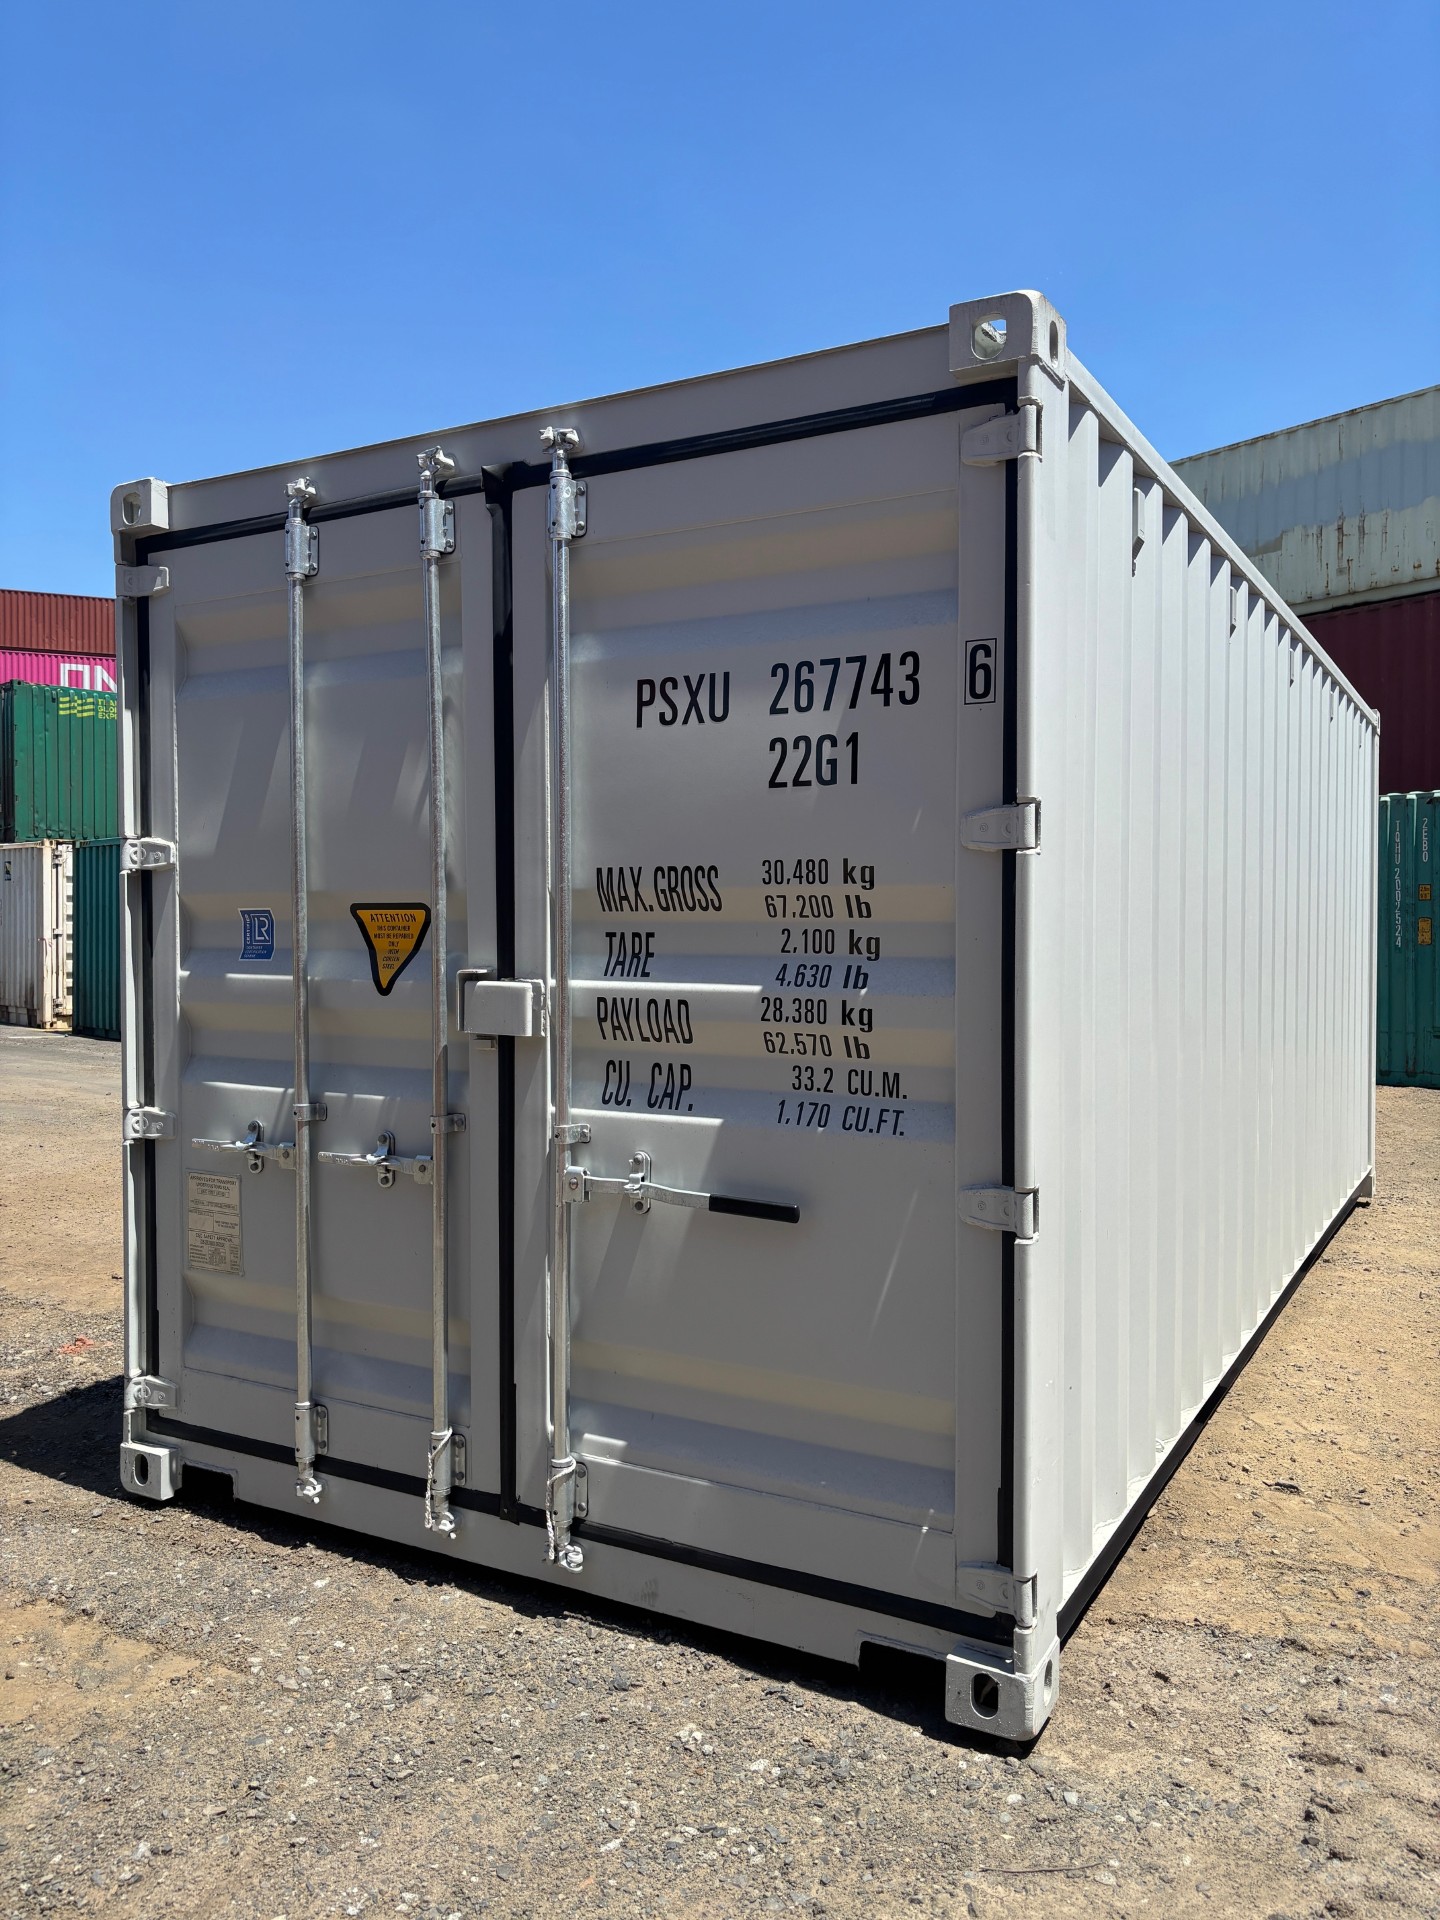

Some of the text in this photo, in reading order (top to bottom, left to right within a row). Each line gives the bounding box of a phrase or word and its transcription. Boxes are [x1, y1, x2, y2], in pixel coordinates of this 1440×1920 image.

[637, 644, 991, 728] PSXU 267743 6
[769, 732, 858, 788] 22G1
[596, 858, 874, 912] MAX.GROSS 30,480 kg
[845, 895, 871, 918] lb
[369, 913, 417, 923] ATTENTION
[604, 928, 880, 977] TARE 2,100 kg
[775, 964, 868, 989] 4,630 lb
[597, 997, 873, 1044] PAYLOAD 28,380 kg
[844, 1036, 870, 1059] lb
[602, 1060, 907, 1111] CU. CAP. 33.2 CU.M.
[778, 1100, 904, 1136] 1,170 CU.FT.
